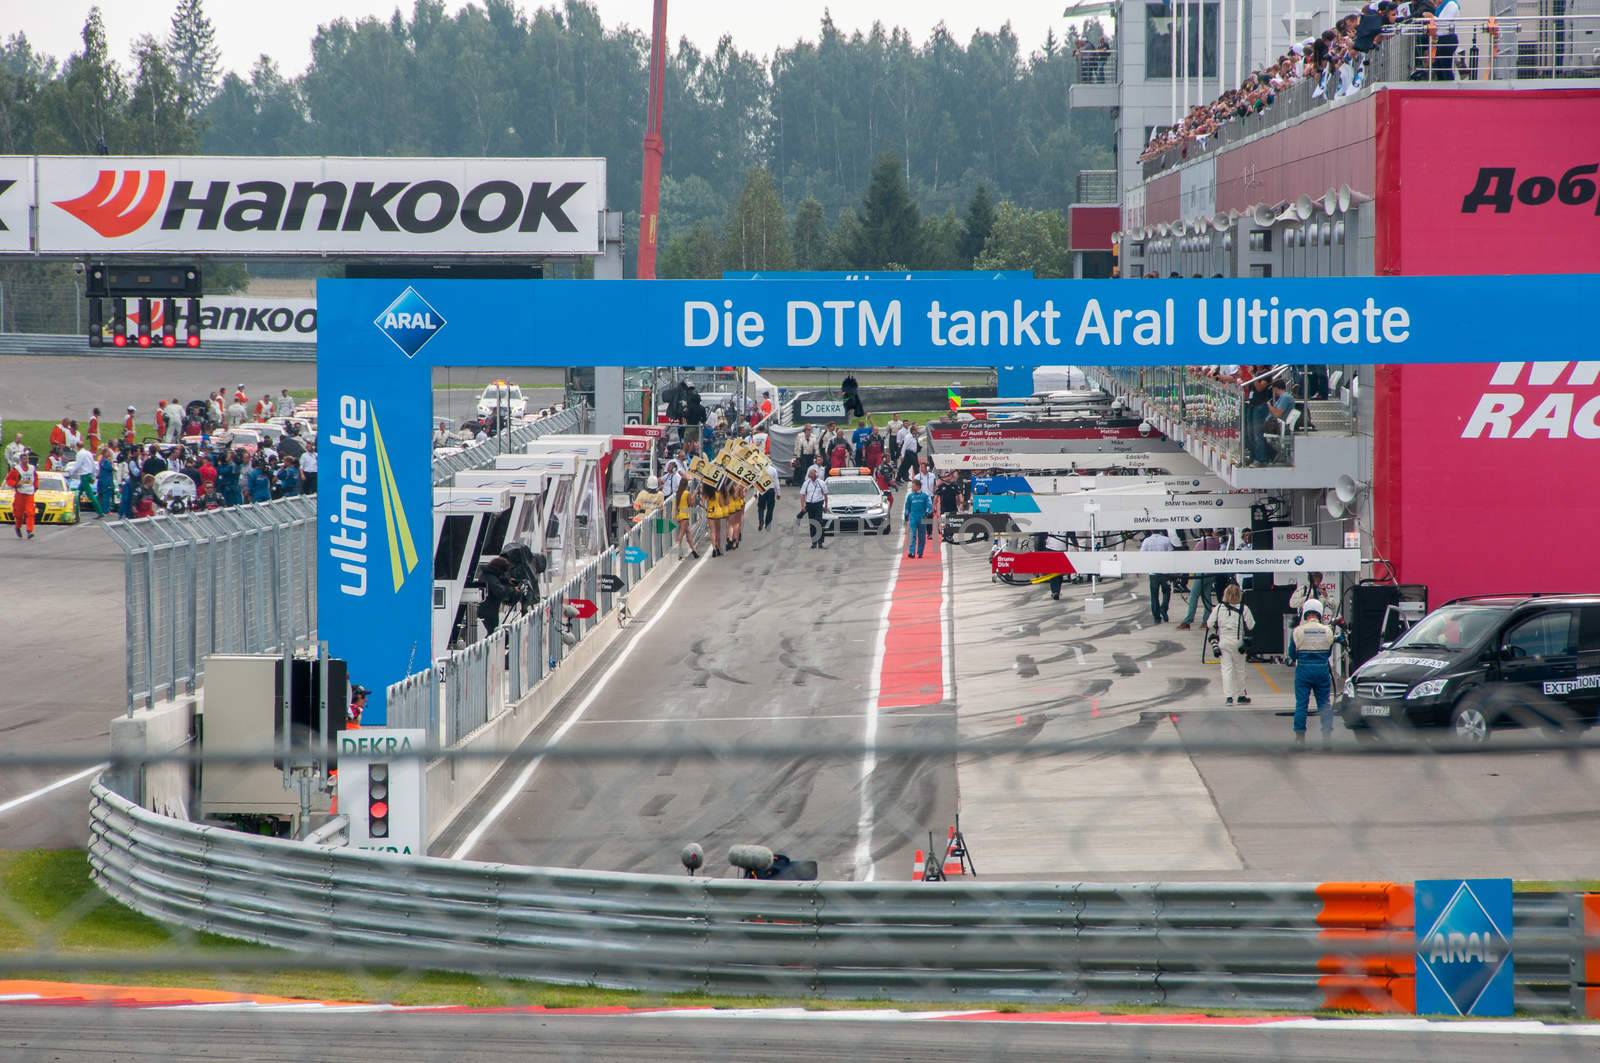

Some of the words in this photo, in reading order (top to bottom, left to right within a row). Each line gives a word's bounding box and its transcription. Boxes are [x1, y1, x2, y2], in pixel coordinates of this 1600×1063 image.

[1461, 163, 1600, 217] Доб
[383, 311, 437, 330] ARAL
[684, 299, 765, 348] Die
[787, 299, 901, 347] DTM
[927, 299, 1061, 347] tankt
[1075, 298, 1174, 346] Aral
[1198, 296, 1410, 346] Ultimate
[815, 404, 841, 413] DEKRA
[744, 470, 756, 482] 23
[329, 395, 367, 597] ultimate
[1286, 532, 1308, 540] BOSCH
[1235, 557, 1254, 565] Team
[1255, 557, 1290, 565] Schnitzer
[341, 736, 415, 756] DEKRA
[1429, 931, 1499, 964] ARAL
